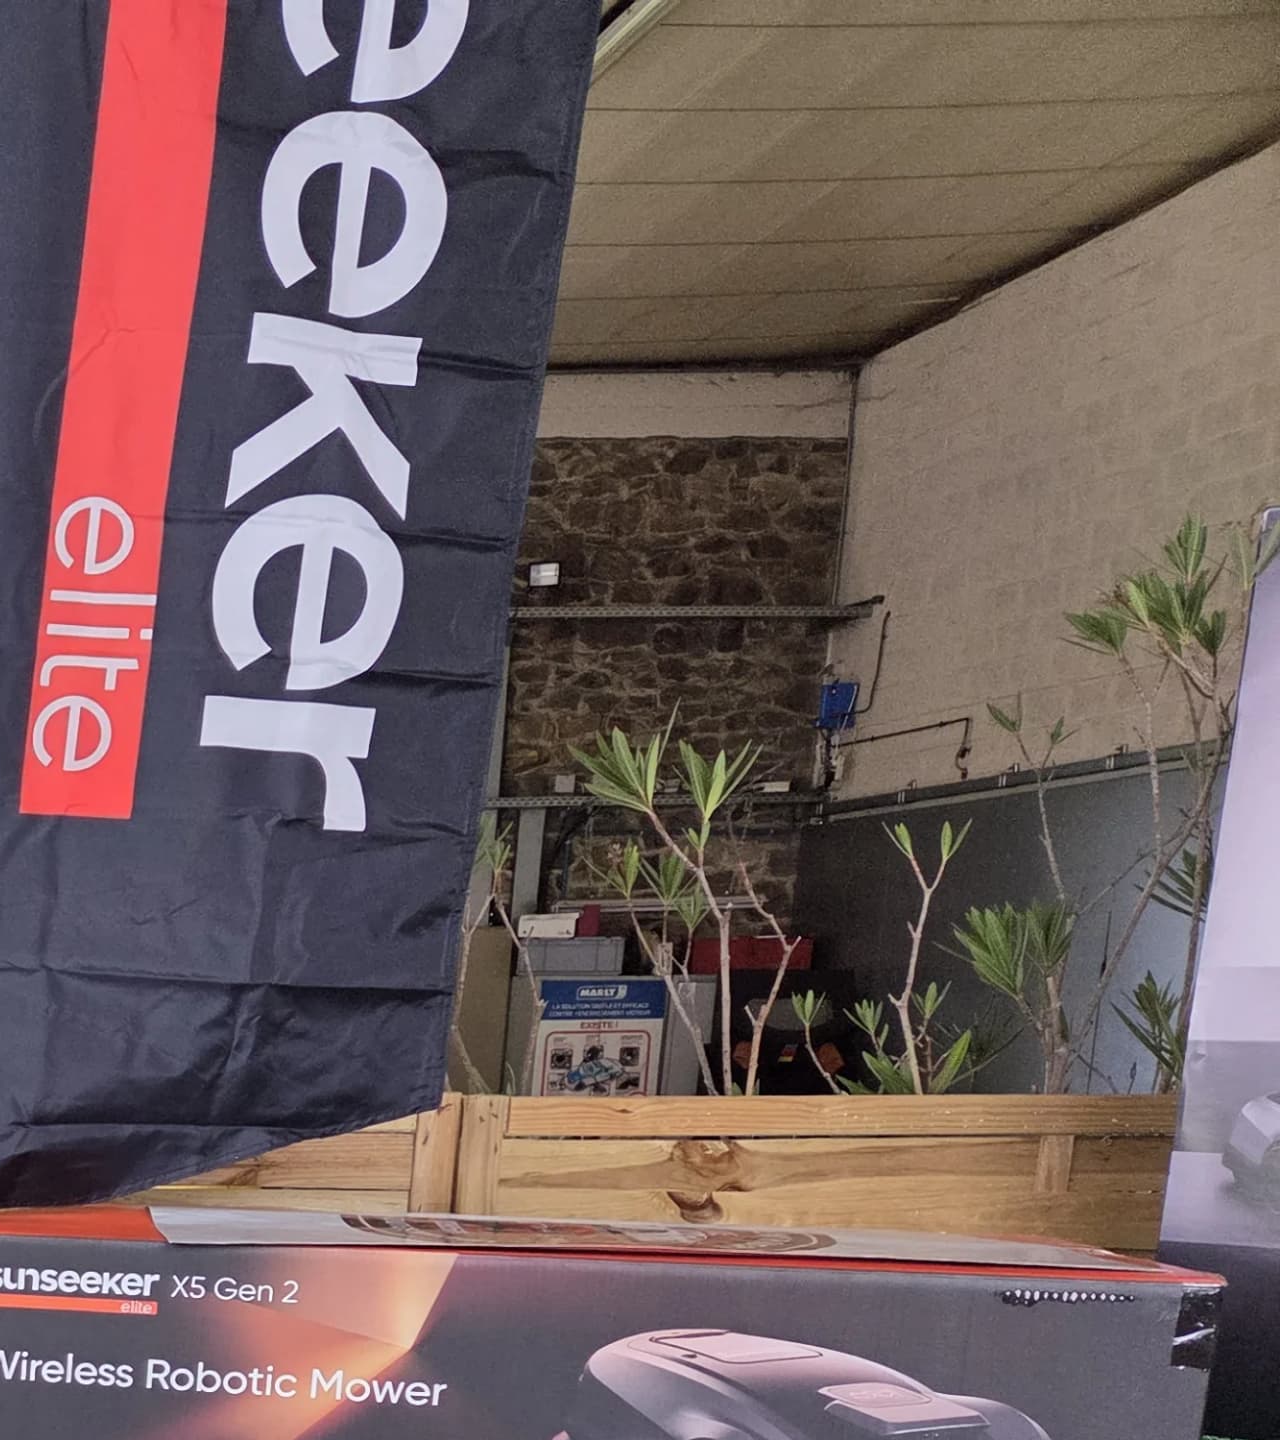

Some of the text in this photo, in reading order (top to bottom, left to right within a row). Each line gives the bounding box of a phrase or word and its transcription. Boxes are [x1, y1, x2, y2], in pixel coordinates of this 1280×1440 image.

[33, 496, 157, 772] elite
[120, 1300, 152, 1315] elite
[171, 1275, 206, 1299] X5
[214, 1277, 273, 1303] Gen
[281, 1280, 299, 1304] 2
[146, 1359, 297, 1398] Robotic
[310, 1369, 447, 1407] Mower
